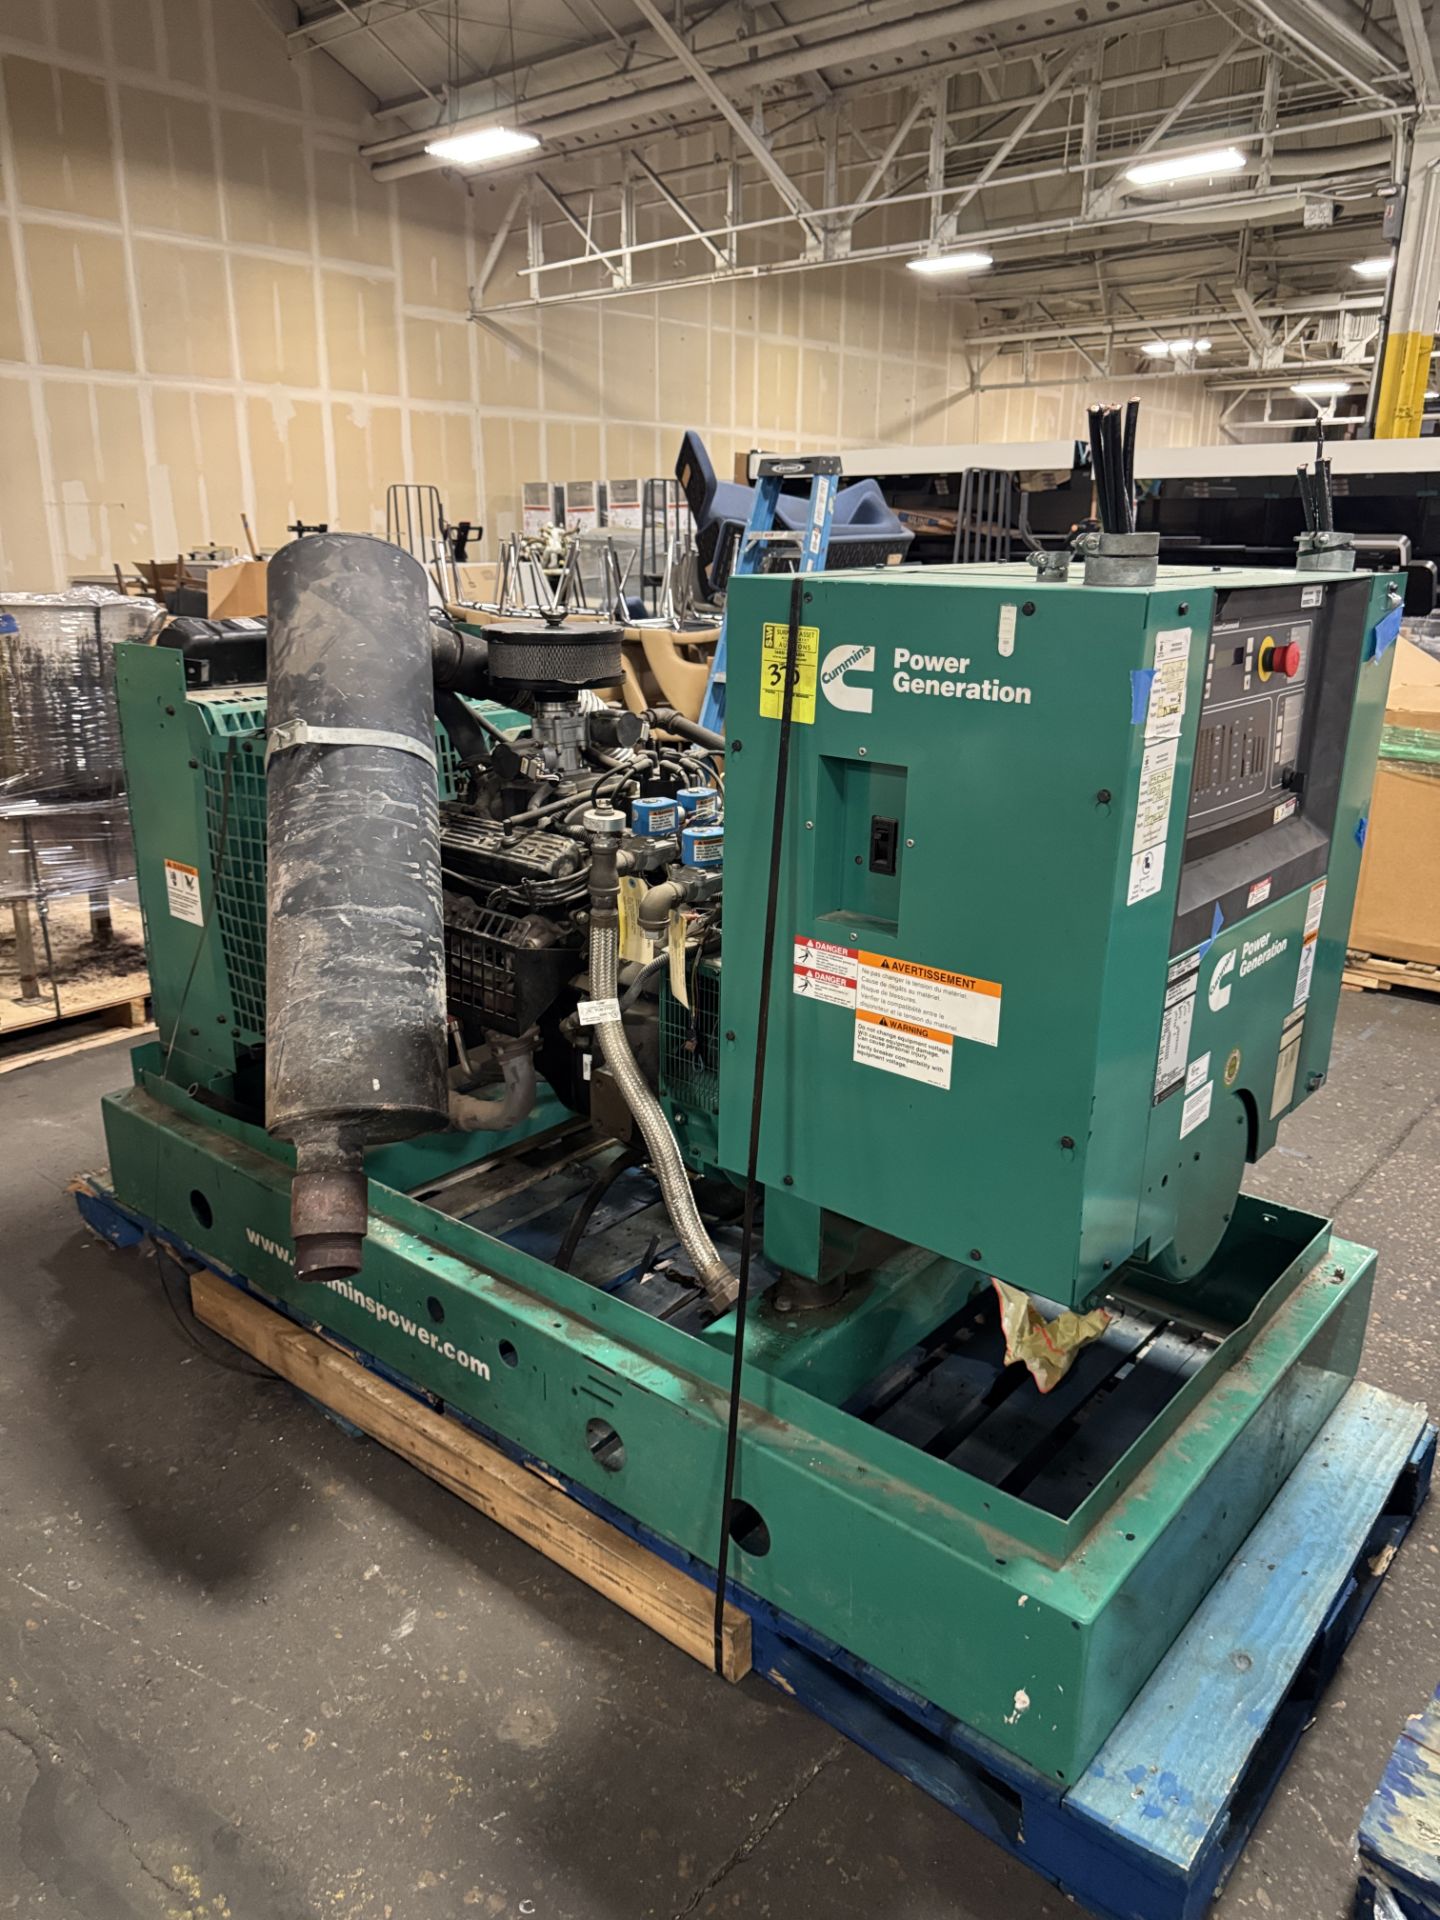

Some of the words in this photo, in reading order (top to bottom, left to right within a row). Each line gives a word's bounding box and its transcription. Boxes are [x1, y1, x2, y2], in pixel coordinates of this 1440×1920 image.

[821, 645, 872, 685] Cummins
[894, 647, 970, 674] Power
[892, 671, 1031, 704] Generation
[815, 941, 848, 956] DANGER
[1239, 938, 1288, 978] Generation
[1241, 932, 1271, 960] Power
[814, 971, 847, 987] DANGER
[861, 976, 878, 985] Cause
[891, 961, 976, 990] AVERTISSEMENT
[876, 1028, 896, 1039] change
[889, 1019, 928, 1038] WARNING
[246, 1227, 490, 1381] www.minspower.com
